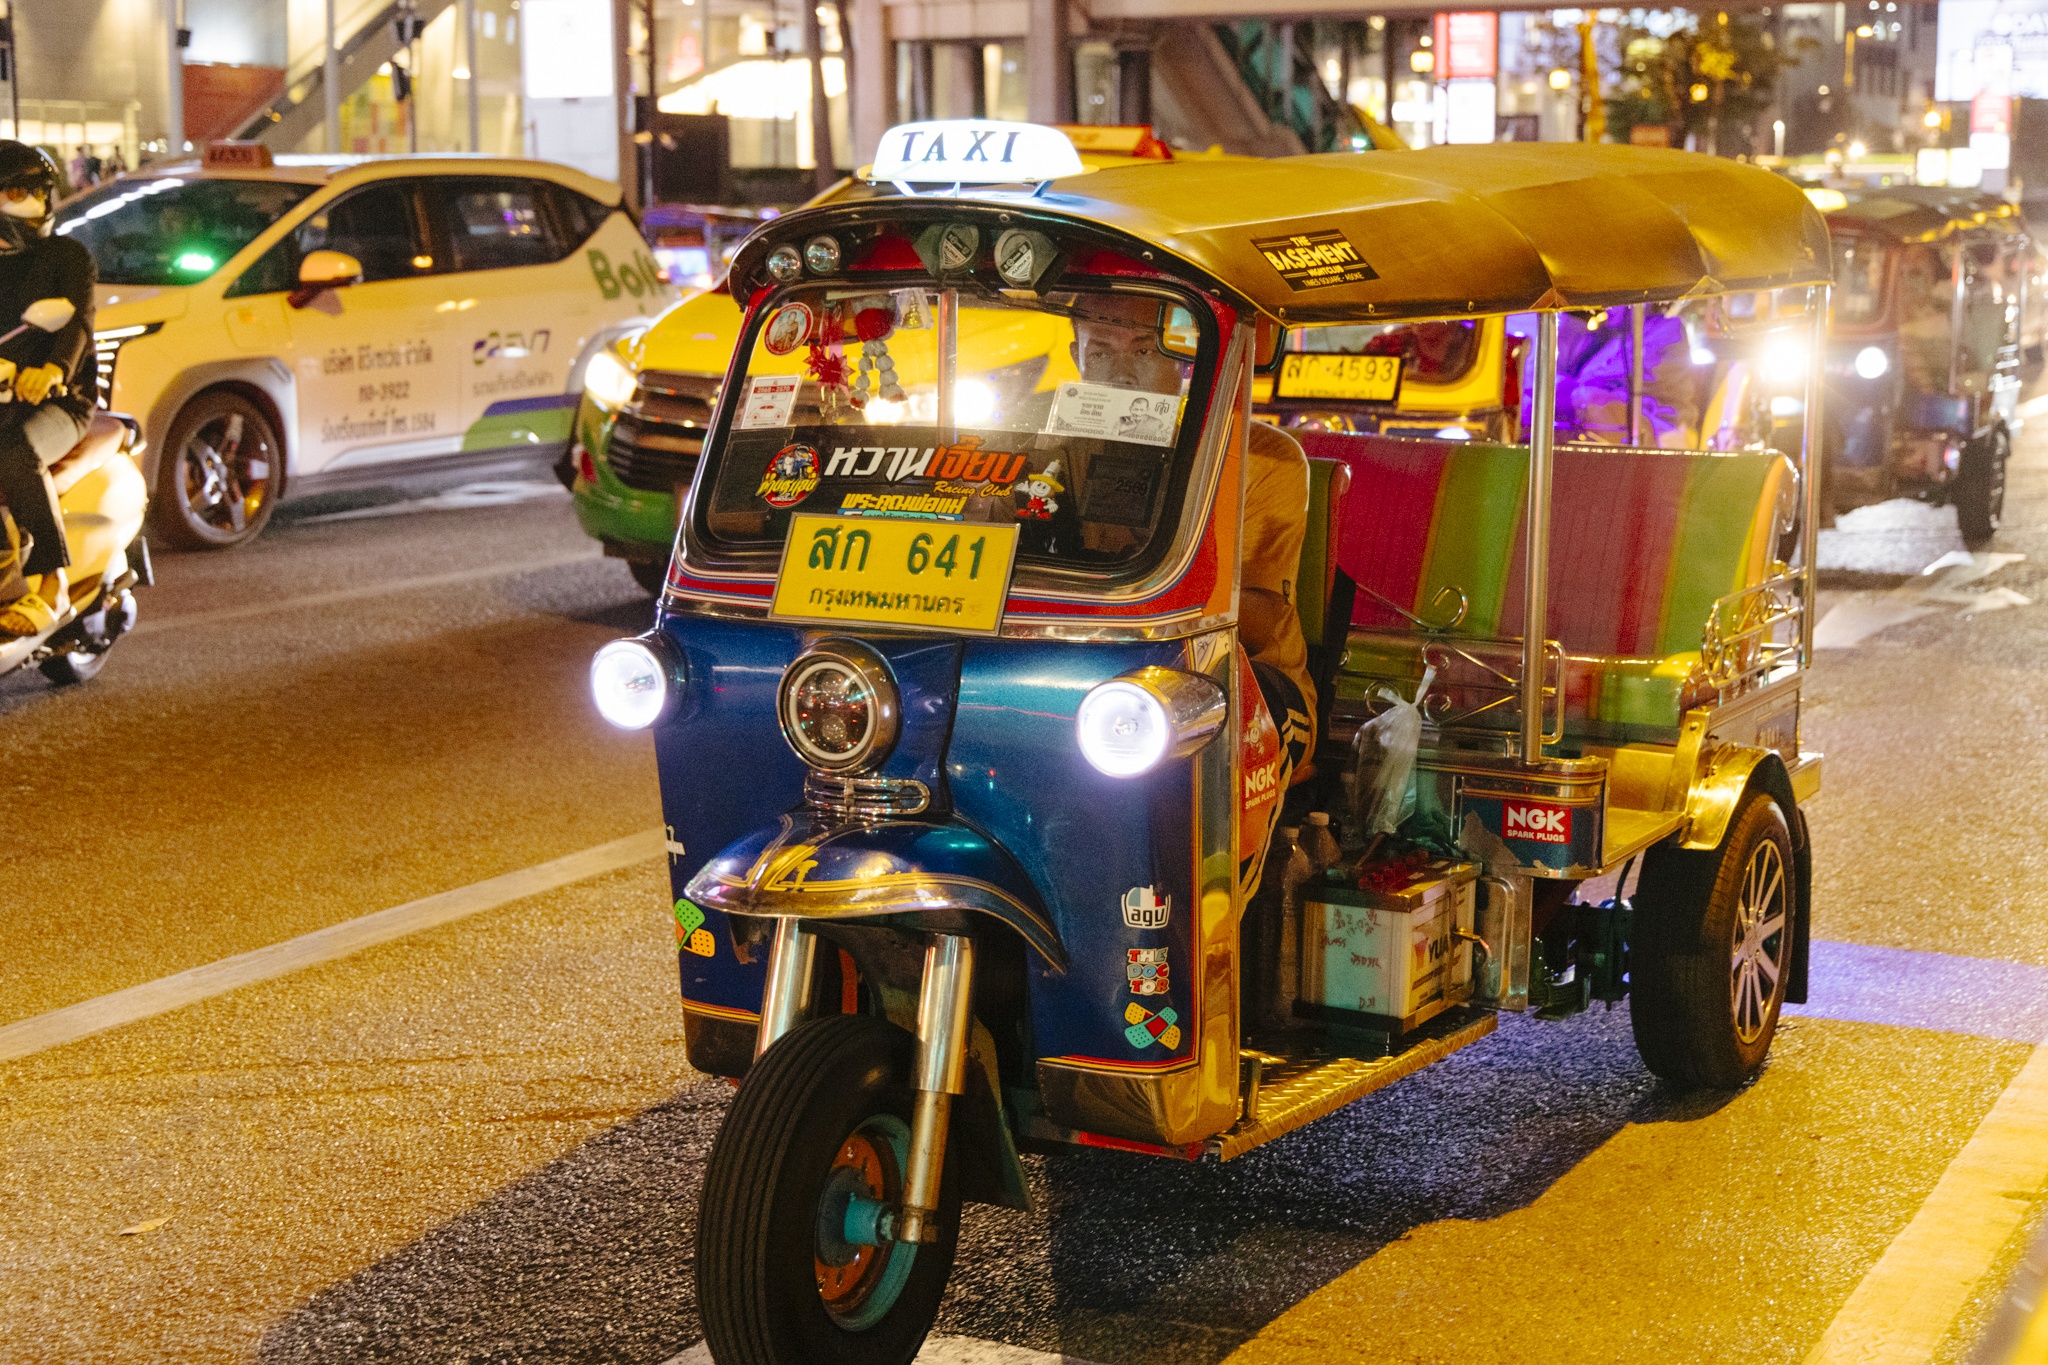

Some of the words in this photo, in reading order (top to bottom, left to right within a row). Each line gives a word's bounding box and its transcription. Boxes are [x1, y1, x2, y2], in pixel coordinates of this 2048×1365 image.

[901, 131, 1021, 162] TAXI
[1289, 235, 1312, 247] THE
[1263, 241, 1359, 271] BASEMENT
[1302, 278, 1322, 287] TIMES
[1319, 275, 1343, 285] SQUARE
[1307, 265, 1345, 277] NIGHTCLUB
[1333, 358, 1394, 382] 4593
[933, 481, 976, 496] Racing
[979, 483, 1014, 498] Club
[840, 492, 968, 514] พระคุณพ่อแม่
[808, 525, 872, 574] สก
[906, 532, 987, 582] 641
[808, 587, 966, 616] กรุงเทพมหานคร
[1245, 761, 1276, 798] NGK
[1245, 796, 1262, 810] SPARK
[1261, 788, 1276, 802] PLUGS
[1507, 806, 1566, 833] NGK
[1507, 829, 1535, 839] SPARK
[1536, 832, 1565, 843] PLUGS
[1129, 949, 1168, 963] THE
[1128, 963, 1169, 979] DOC
[1131, 978, 1170, 995] TOR
